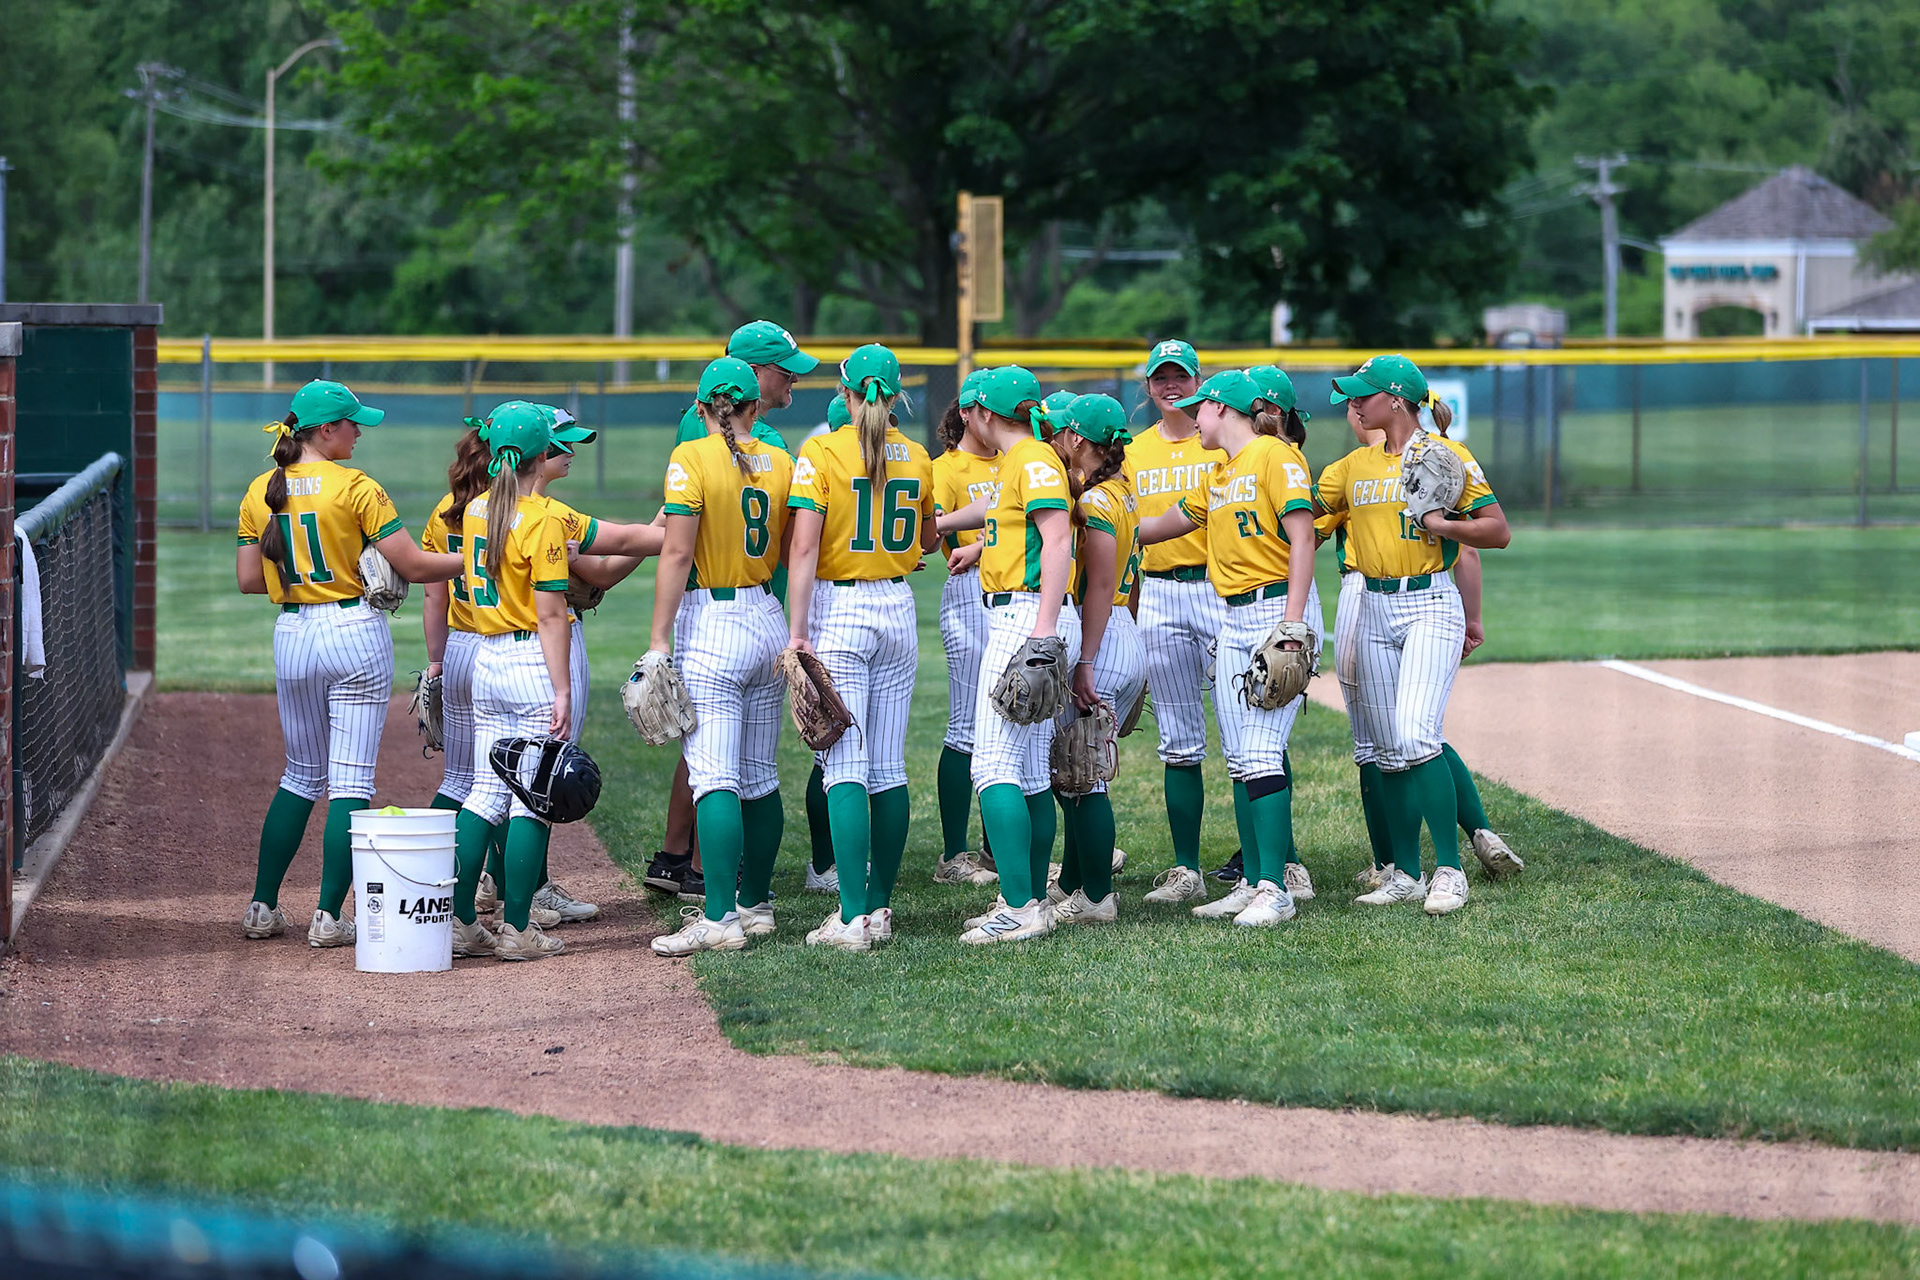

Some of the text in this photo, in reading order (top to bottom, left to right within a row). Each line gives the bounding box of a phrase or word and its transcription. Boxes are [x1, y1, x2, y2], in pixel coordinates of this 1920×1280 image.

[268, 511, 336, 586] 11
[740, 485, 771, 559] 8
[849, 477, 921, 554] 16
[1234, 510, 1265, 539] 21
